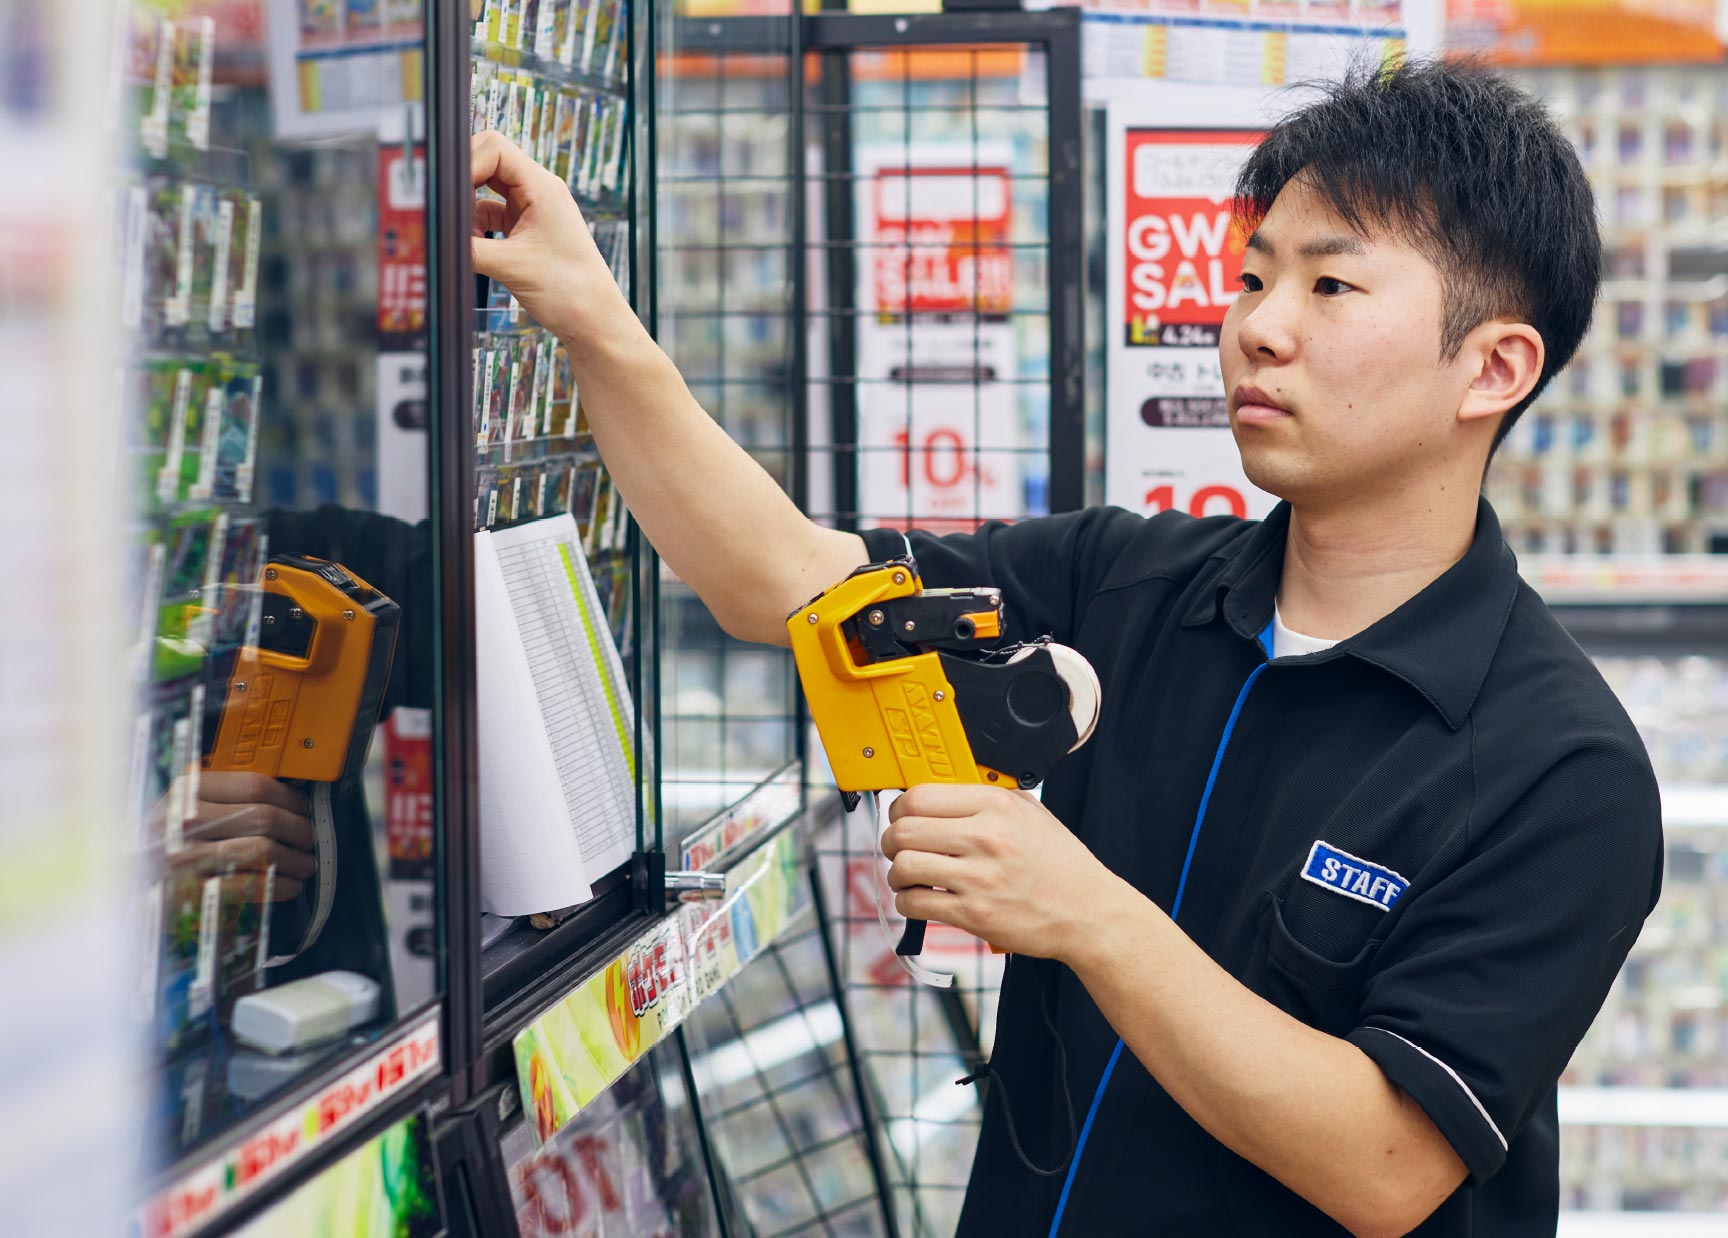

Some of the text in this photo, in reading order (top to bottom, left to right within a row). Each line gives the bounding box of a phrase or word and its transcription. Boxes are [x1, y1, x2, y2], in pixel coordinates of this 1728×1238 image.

[1128, 212, 1230, 260] GW
[1131, 259, 1242, 310] SAL
[1321, 857, 1401, 905] STAFF
